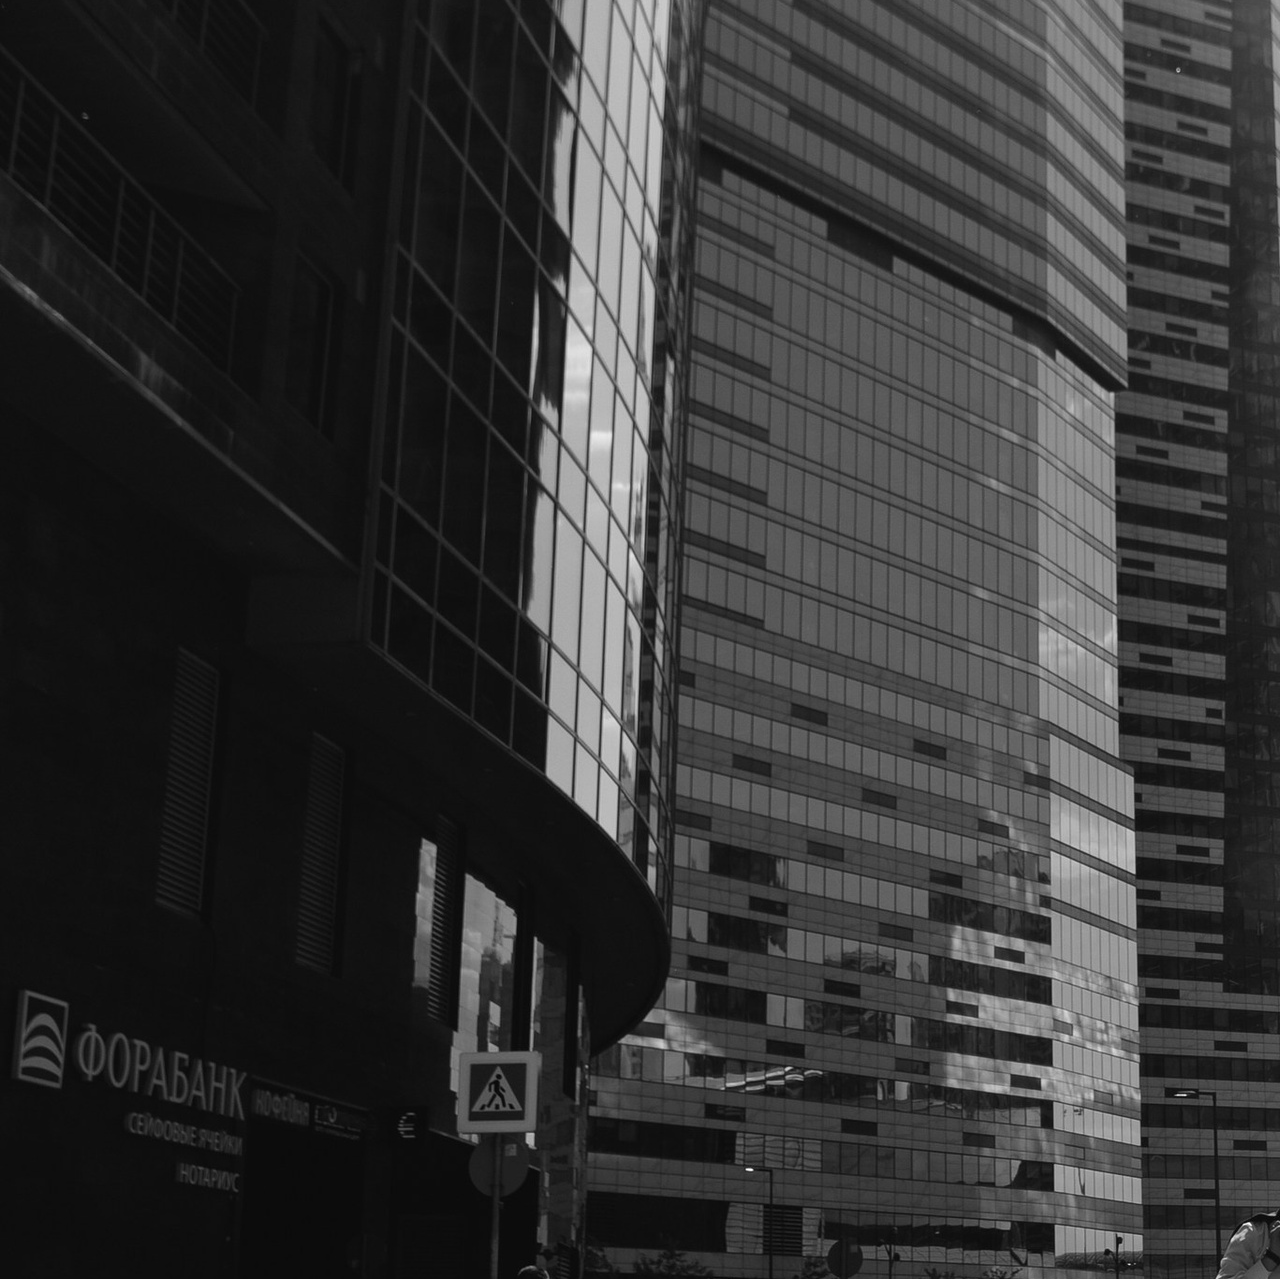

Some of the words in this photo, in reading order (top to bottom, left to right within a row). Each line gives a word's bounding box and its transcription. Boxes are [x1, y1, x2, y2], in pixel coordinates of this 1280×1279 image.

[73, 1022, 248, 1122] ФОРАБАНК
[125, 1111, 197, 1148] СЕЙФОВЫЕ
[199, 1127, 244, 1157] ЯЧЕЙКИ
[175, 1162, 241, 1193] НОТАРИУС
